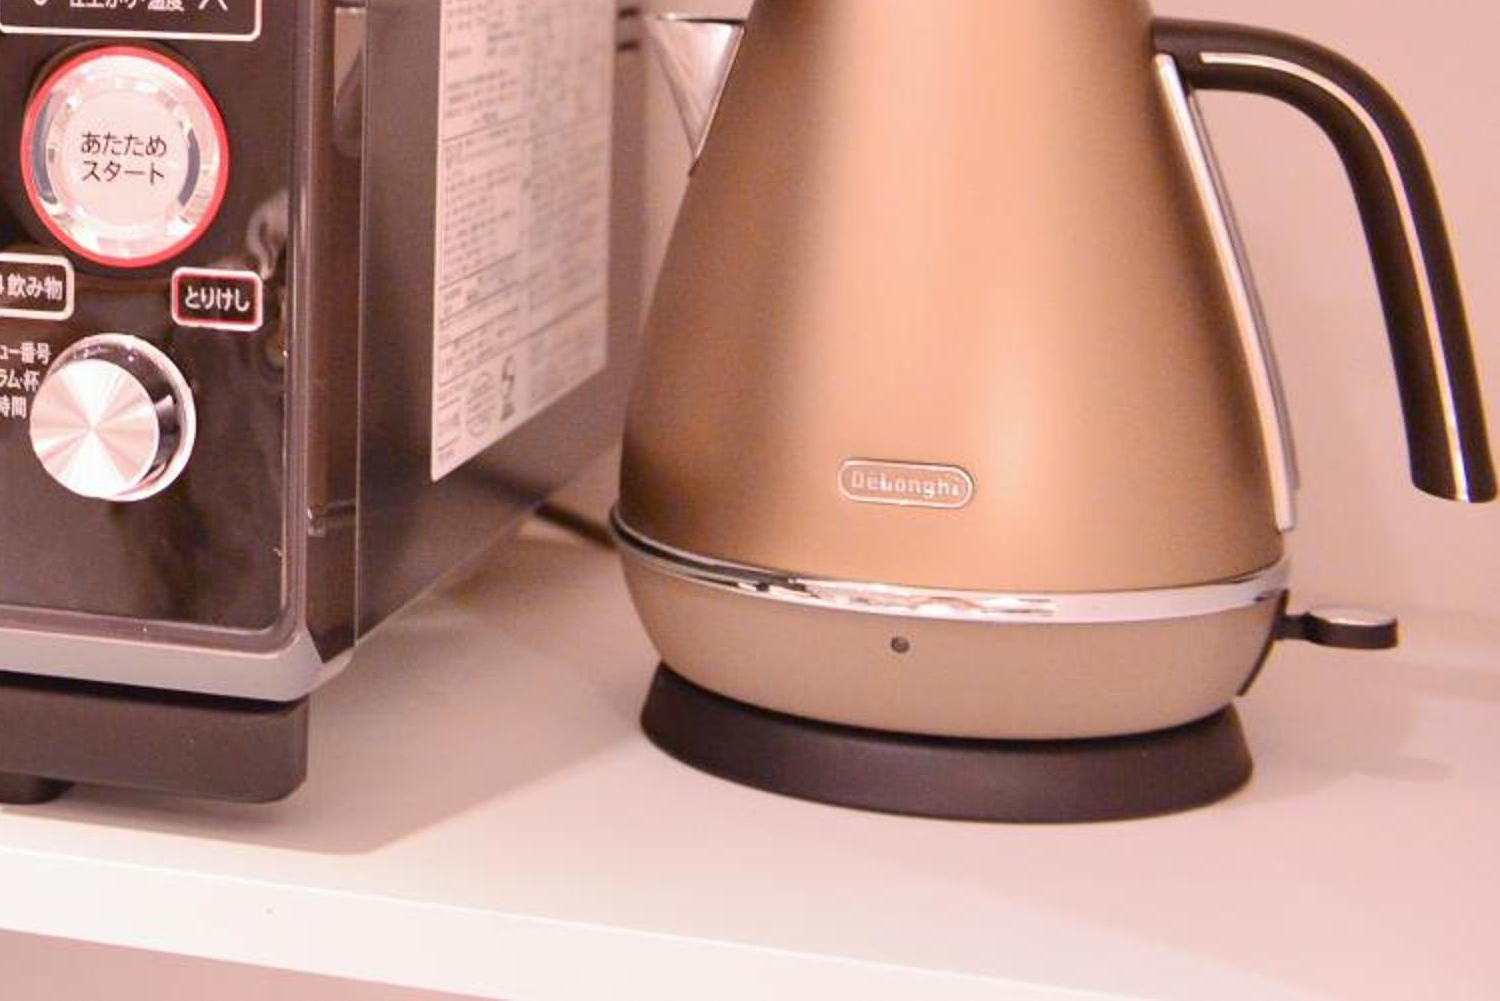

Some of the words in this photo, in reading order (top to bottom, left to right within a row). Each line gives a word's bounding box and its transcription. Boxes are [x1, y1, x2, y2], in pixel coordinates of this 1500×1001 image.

[80, 132, 167, 157] あたため
[82, 159, 165, 185] スタート
[7, 275, 63, 301] 飲み物
[184, 286, 250, 312] とりけし
